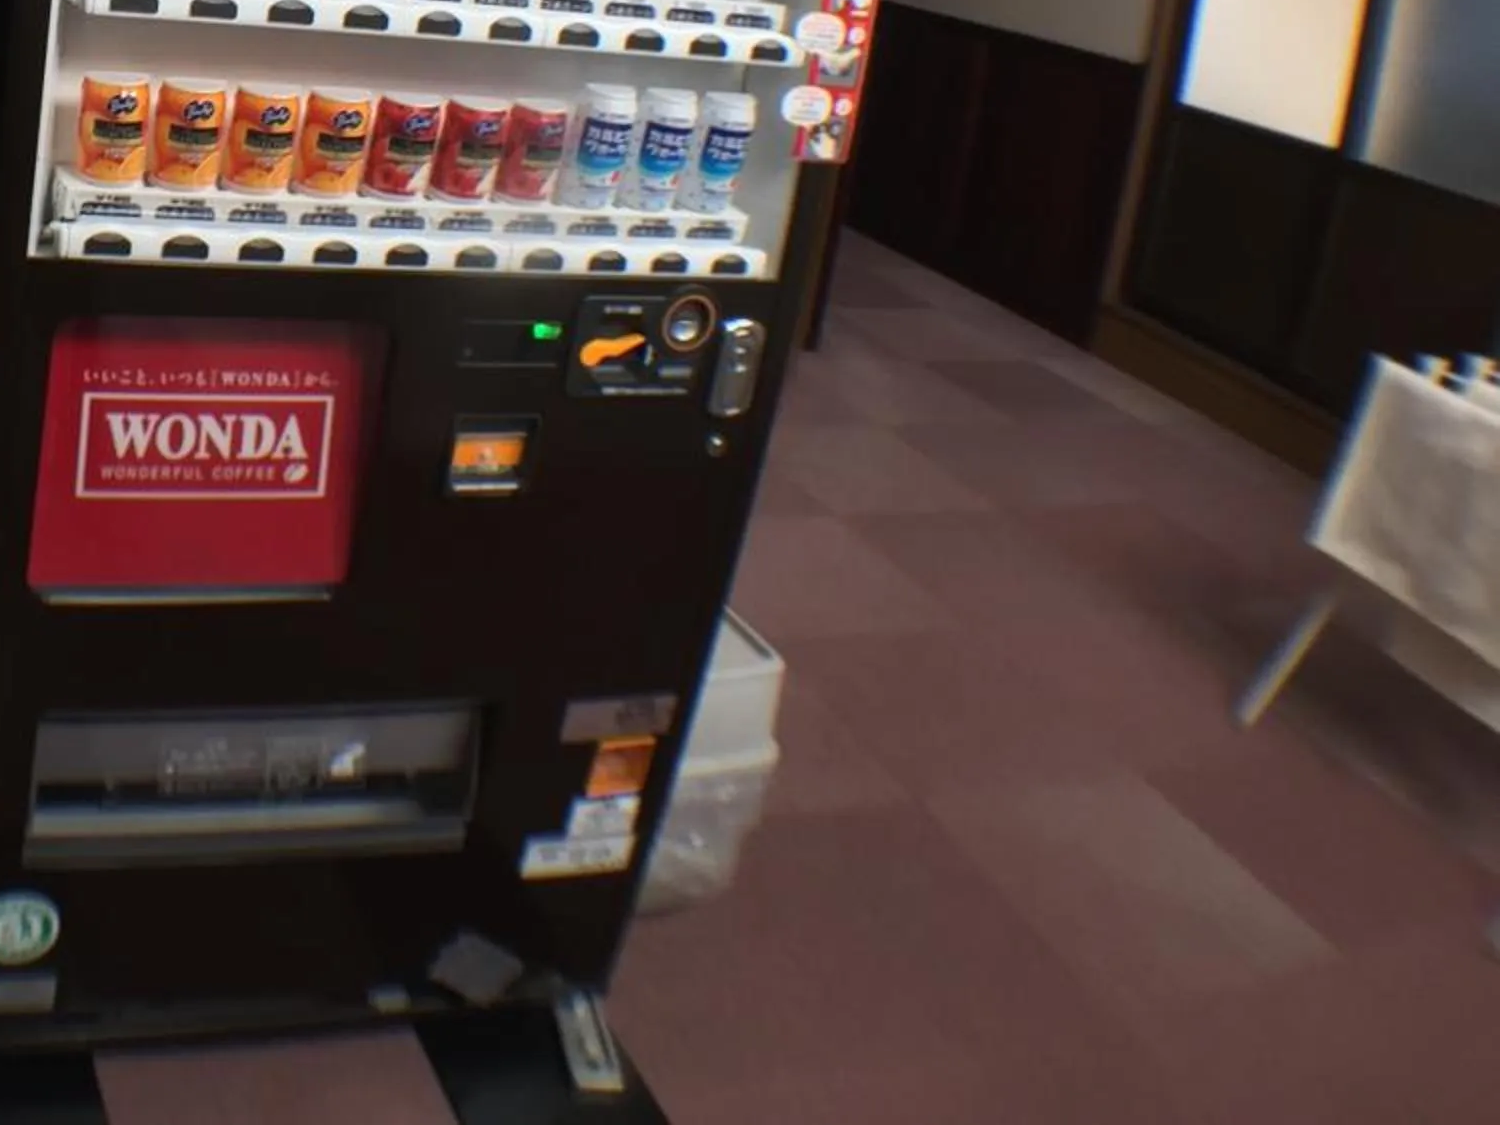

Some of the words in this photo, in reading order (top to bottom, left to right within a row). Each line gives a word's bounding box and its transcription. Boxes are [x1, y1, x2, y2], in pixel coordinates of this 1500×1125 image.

[105, 412, 308, 461] WONDA
[100, 463, 204, 481] WONDERFUL
[212, 465, 276, 481] COFFEE
